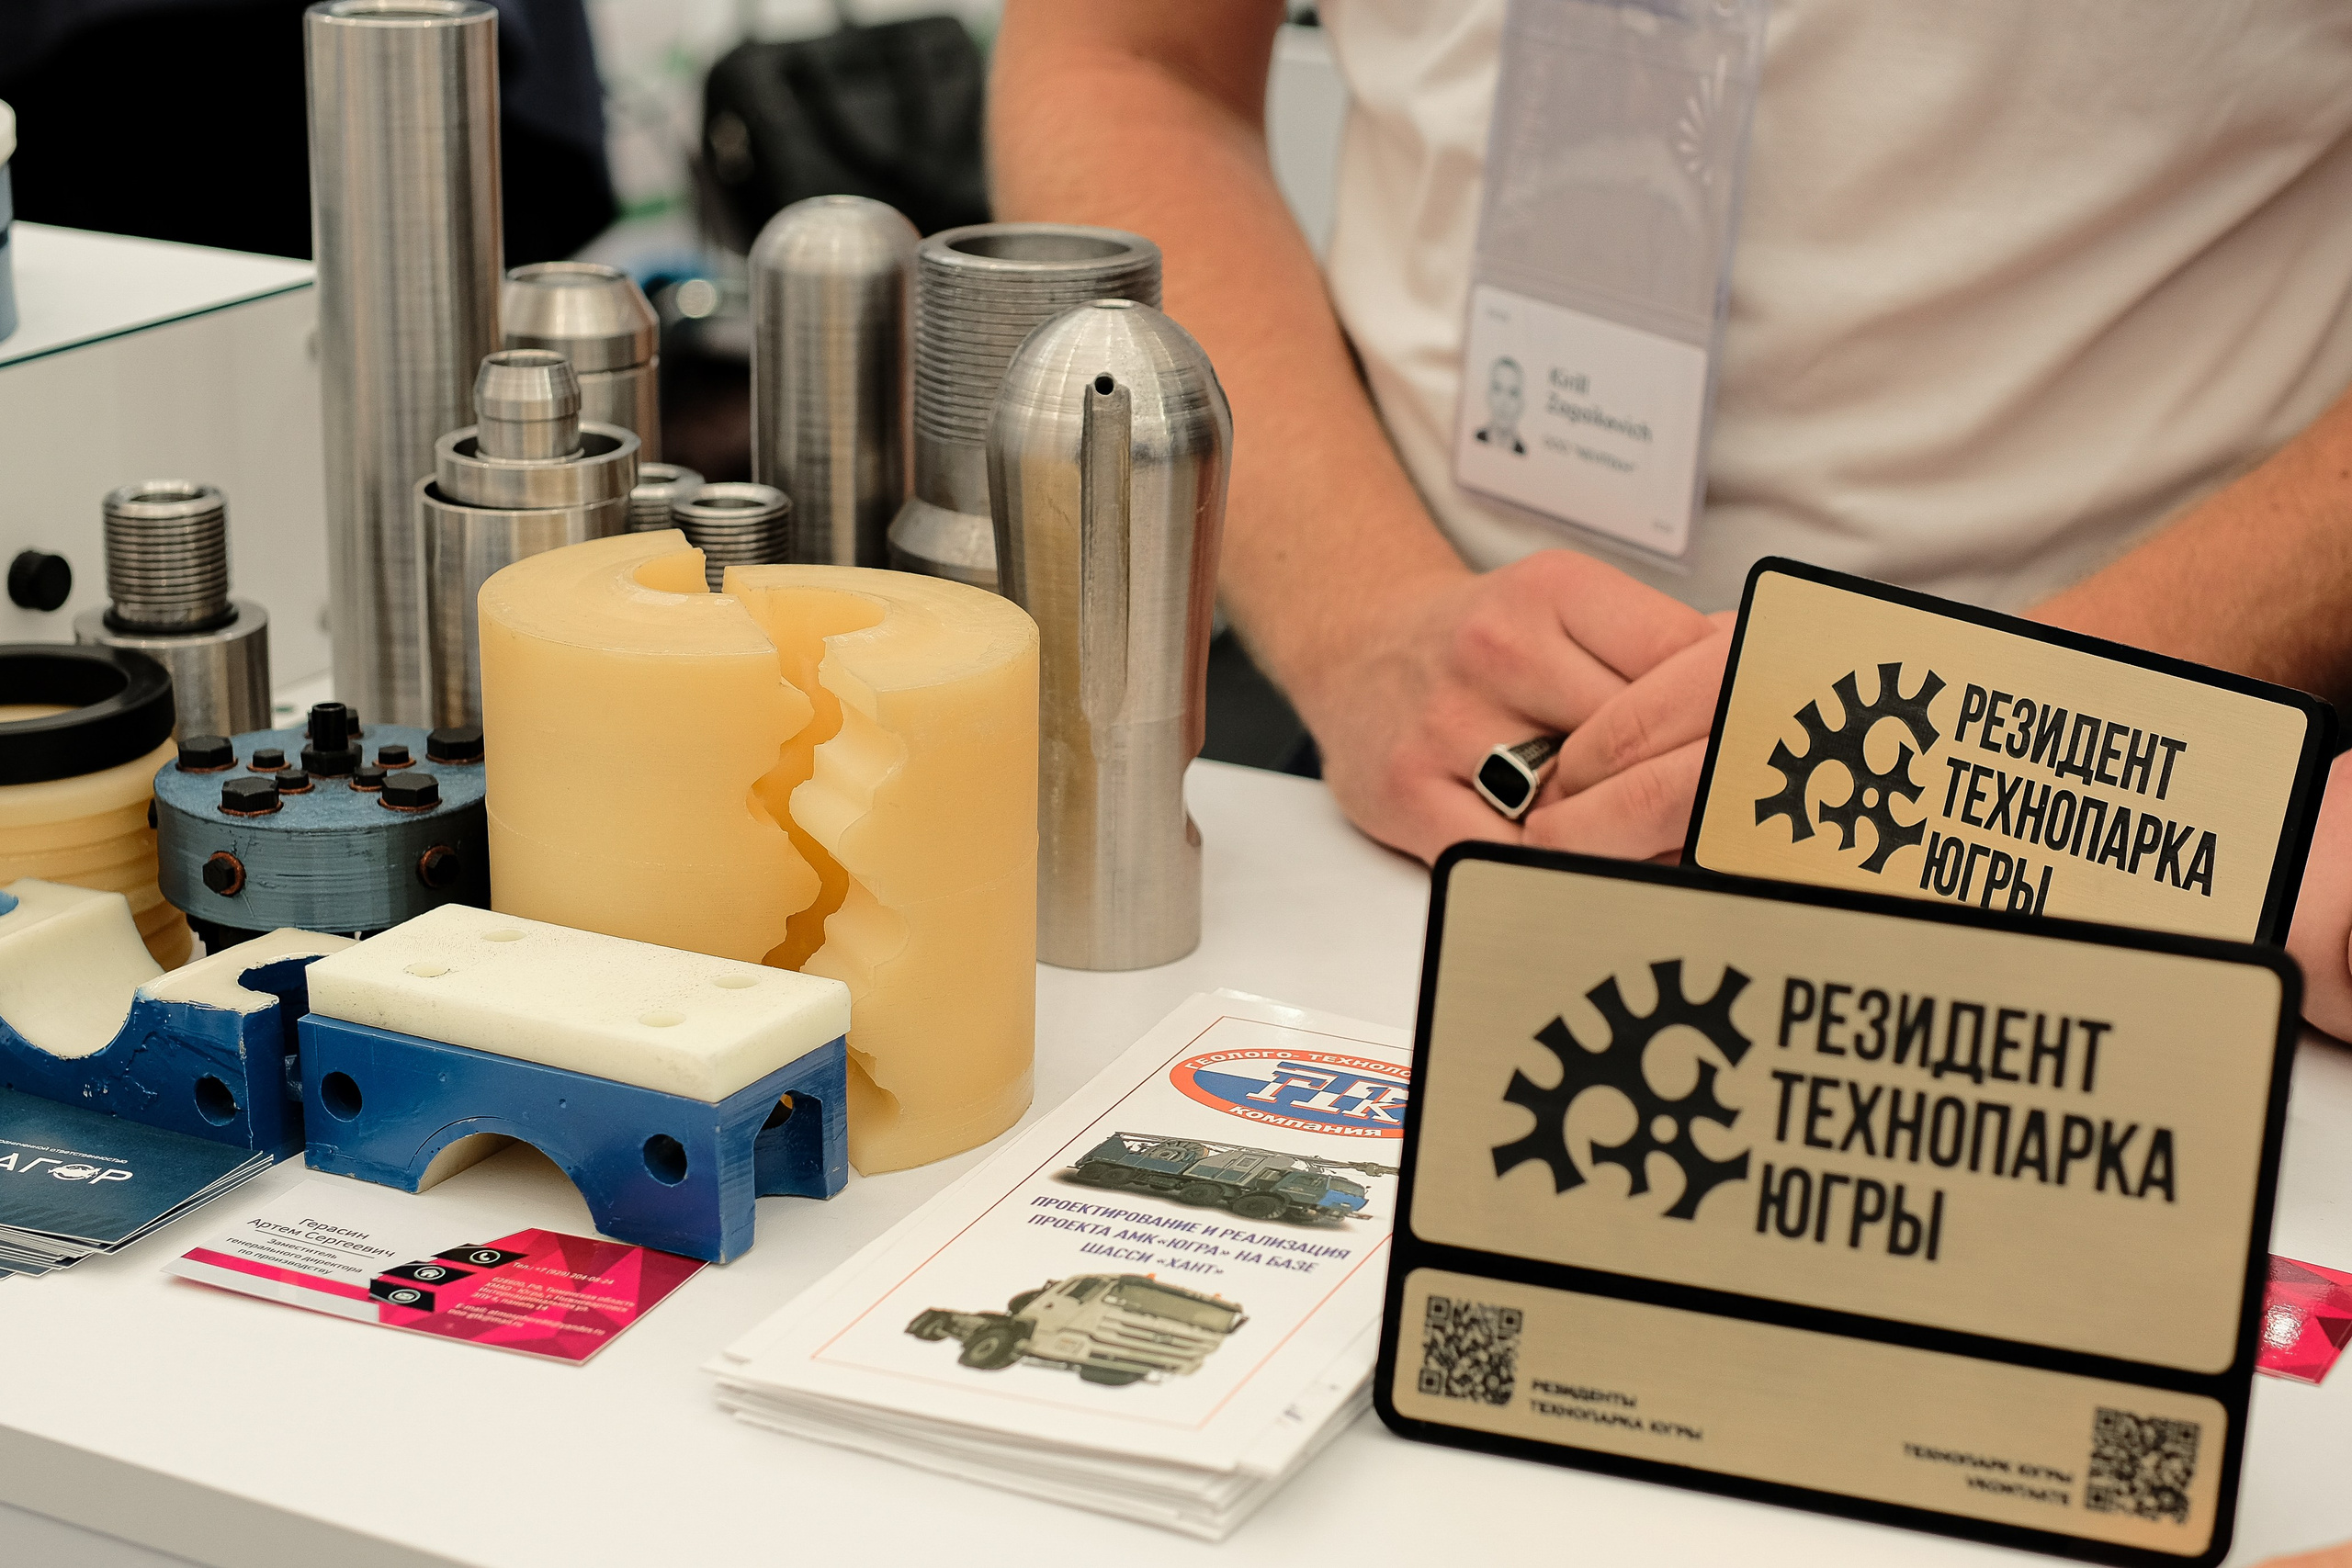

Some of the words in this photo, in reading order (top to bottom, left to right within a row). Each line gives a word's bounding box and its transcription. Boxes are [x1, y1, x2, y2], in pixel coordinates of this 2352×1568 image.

[1953, 682, 2188, 801] РЕЗИДЕНТ
[1941, 756, 2218, 897] ТЕХНОПАРКА
[1918, 830, 2054, 916] ЮГРЫ
[1778, 976, 2112, 1093] РЕЗИДЕНТ
[50, 1147, 128, 1164] ответственностью
[1770, 1069, 2177, 1203] ТЕХНОПАРКА
[247, 1218, 302, 1236] Артем
[304, 1229, 397, 1258] Сергеевич
[299, 1218, 370, 1241] Герасин
[1030, 1195, 1202, 1235] ПРОЕКТИРОВАНИЕ
[1202, 1225, 1220, 1237] И
[1220, 1228, 1351, 1260] РЕАЛИЗАЦИЯ
[1754, 1162, 1945, 1262] ЮГРЫ
[226, 1237, 302, 1259] генерального
[302, 1255, 363, 1274] директора
[254, 1251, 334, 1275] производству
[266, 1238, 337, 1259] Заместитель
[1027, 1213, 1114, 1236] ПРОЕКТА
[1234, 1251, 1263, 1264] НА
[1265, 1256, 1318, 1274] БАЗЕ
[1080, 1242, 1153, 1263] ШАССИ
[1156, 1256, 1225, 1275] «ХАНТ»
